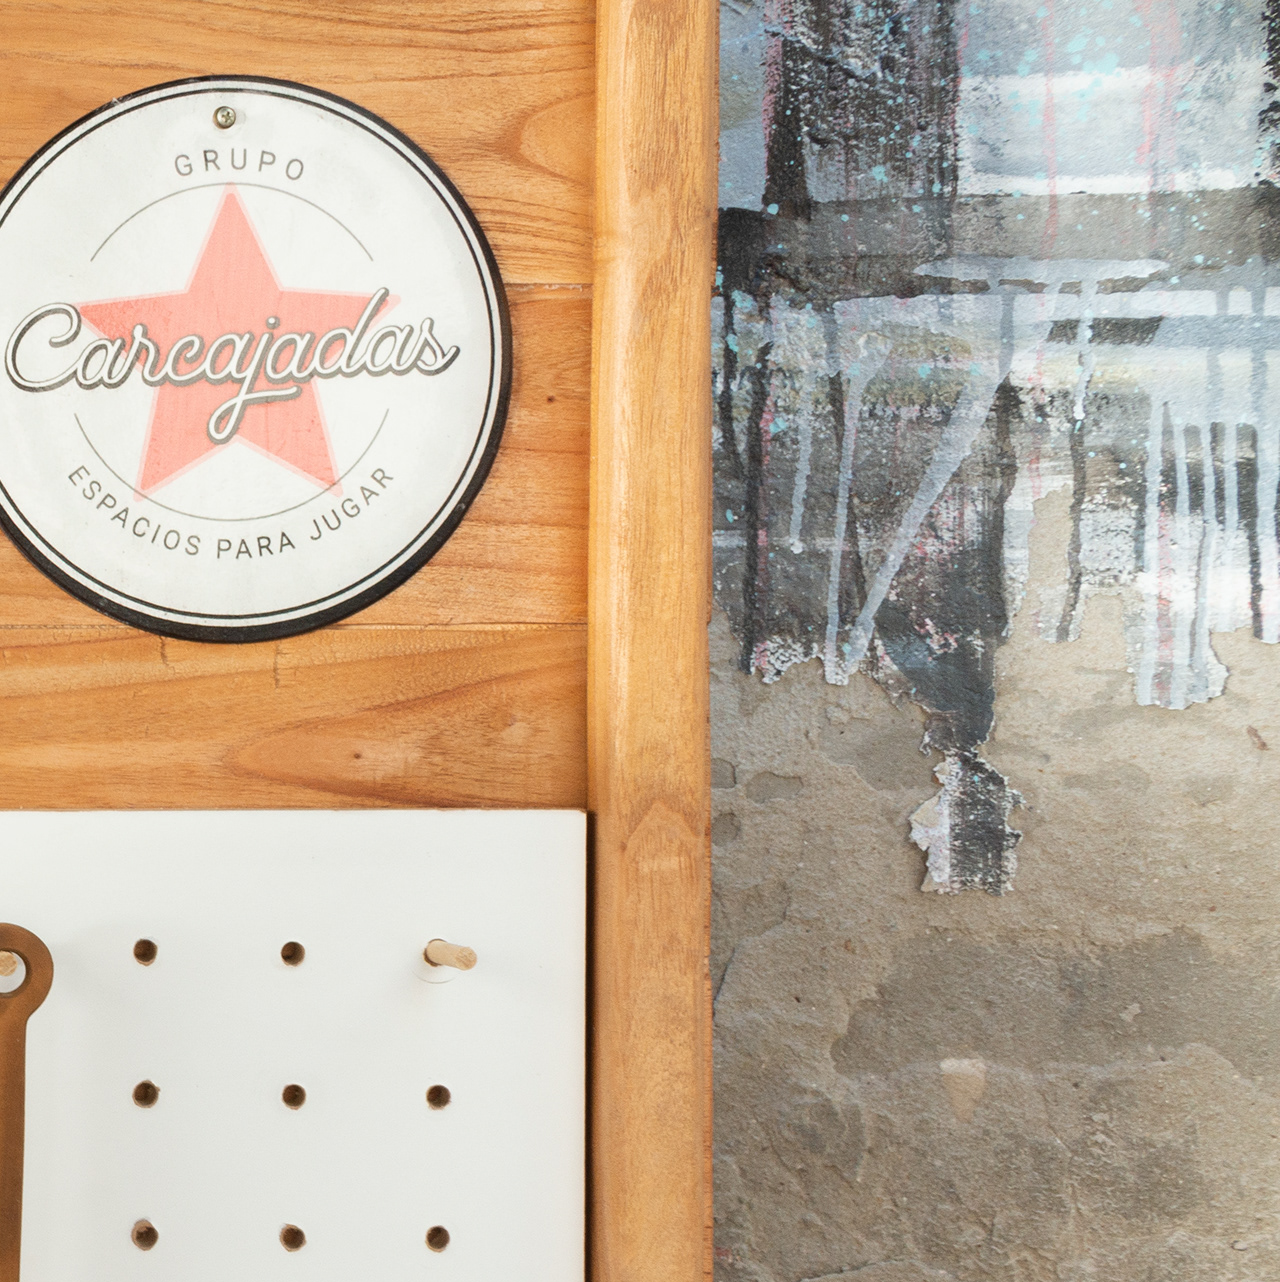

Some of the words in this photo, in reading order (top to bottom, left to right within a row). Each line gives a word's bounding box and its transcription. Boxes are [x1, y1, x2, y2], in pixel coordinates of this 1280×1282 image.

[174, 148, 306, 181] GRUPO
[4, 287, 460, 445] Carcajadas
[67, 464, 201, 557] ESPACIOS
[216, 531, 297, 560] PARA
[310, 467, 394, 542] JUGAR
